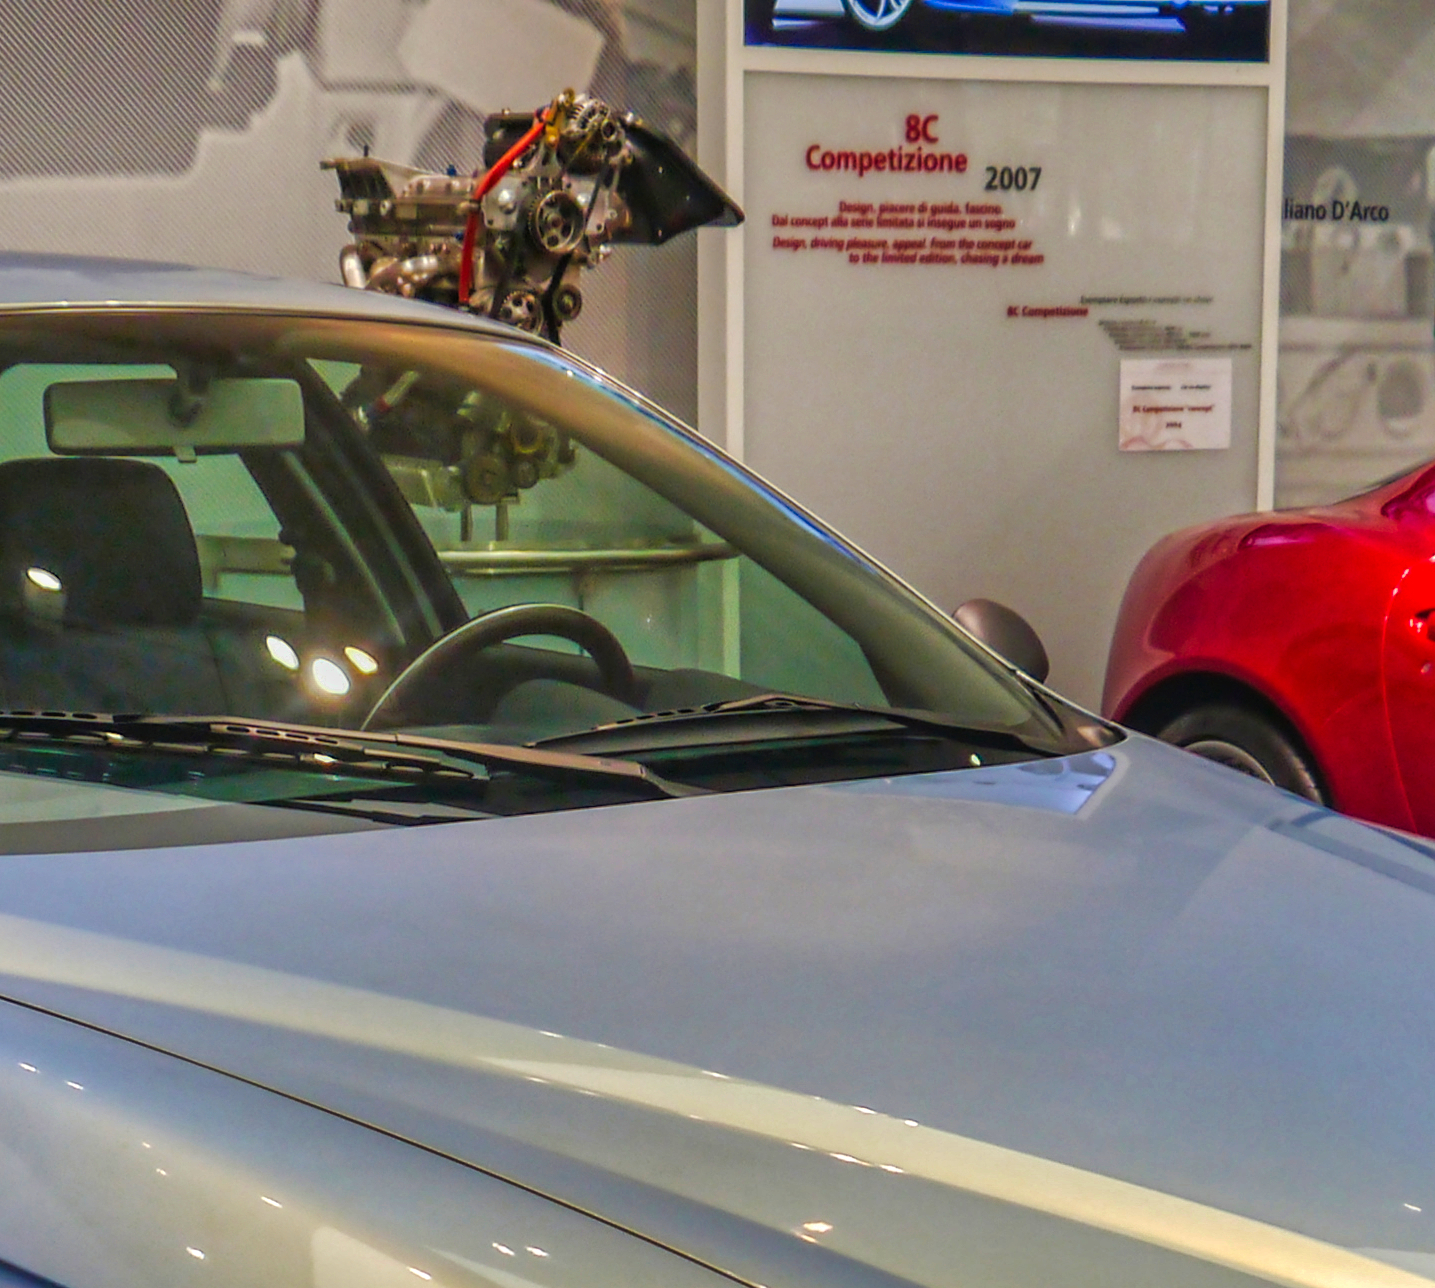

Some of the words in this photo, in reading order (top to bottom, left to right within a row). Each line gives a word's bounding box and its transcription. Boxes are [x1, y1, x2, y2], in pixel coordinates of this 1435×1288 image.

[905, 114, 939, 144] 8C
[806, 145, 968, 177] Competizione
[985, 166, 1043, 191] 2007
[1332, 199, 1389, 221] D'Arco
[791, 215, 828, 230] concept
[958, 238, 975, 250] the
[849, 252, 860, 264] to
[862, 251, 879, 264] the
[881, 251, 917, 264] limited
[961, 251, 1000, 268] chasing
[1011, 252, 1045, 265] dream
[1022, 306, 1089, 319] Competizione
